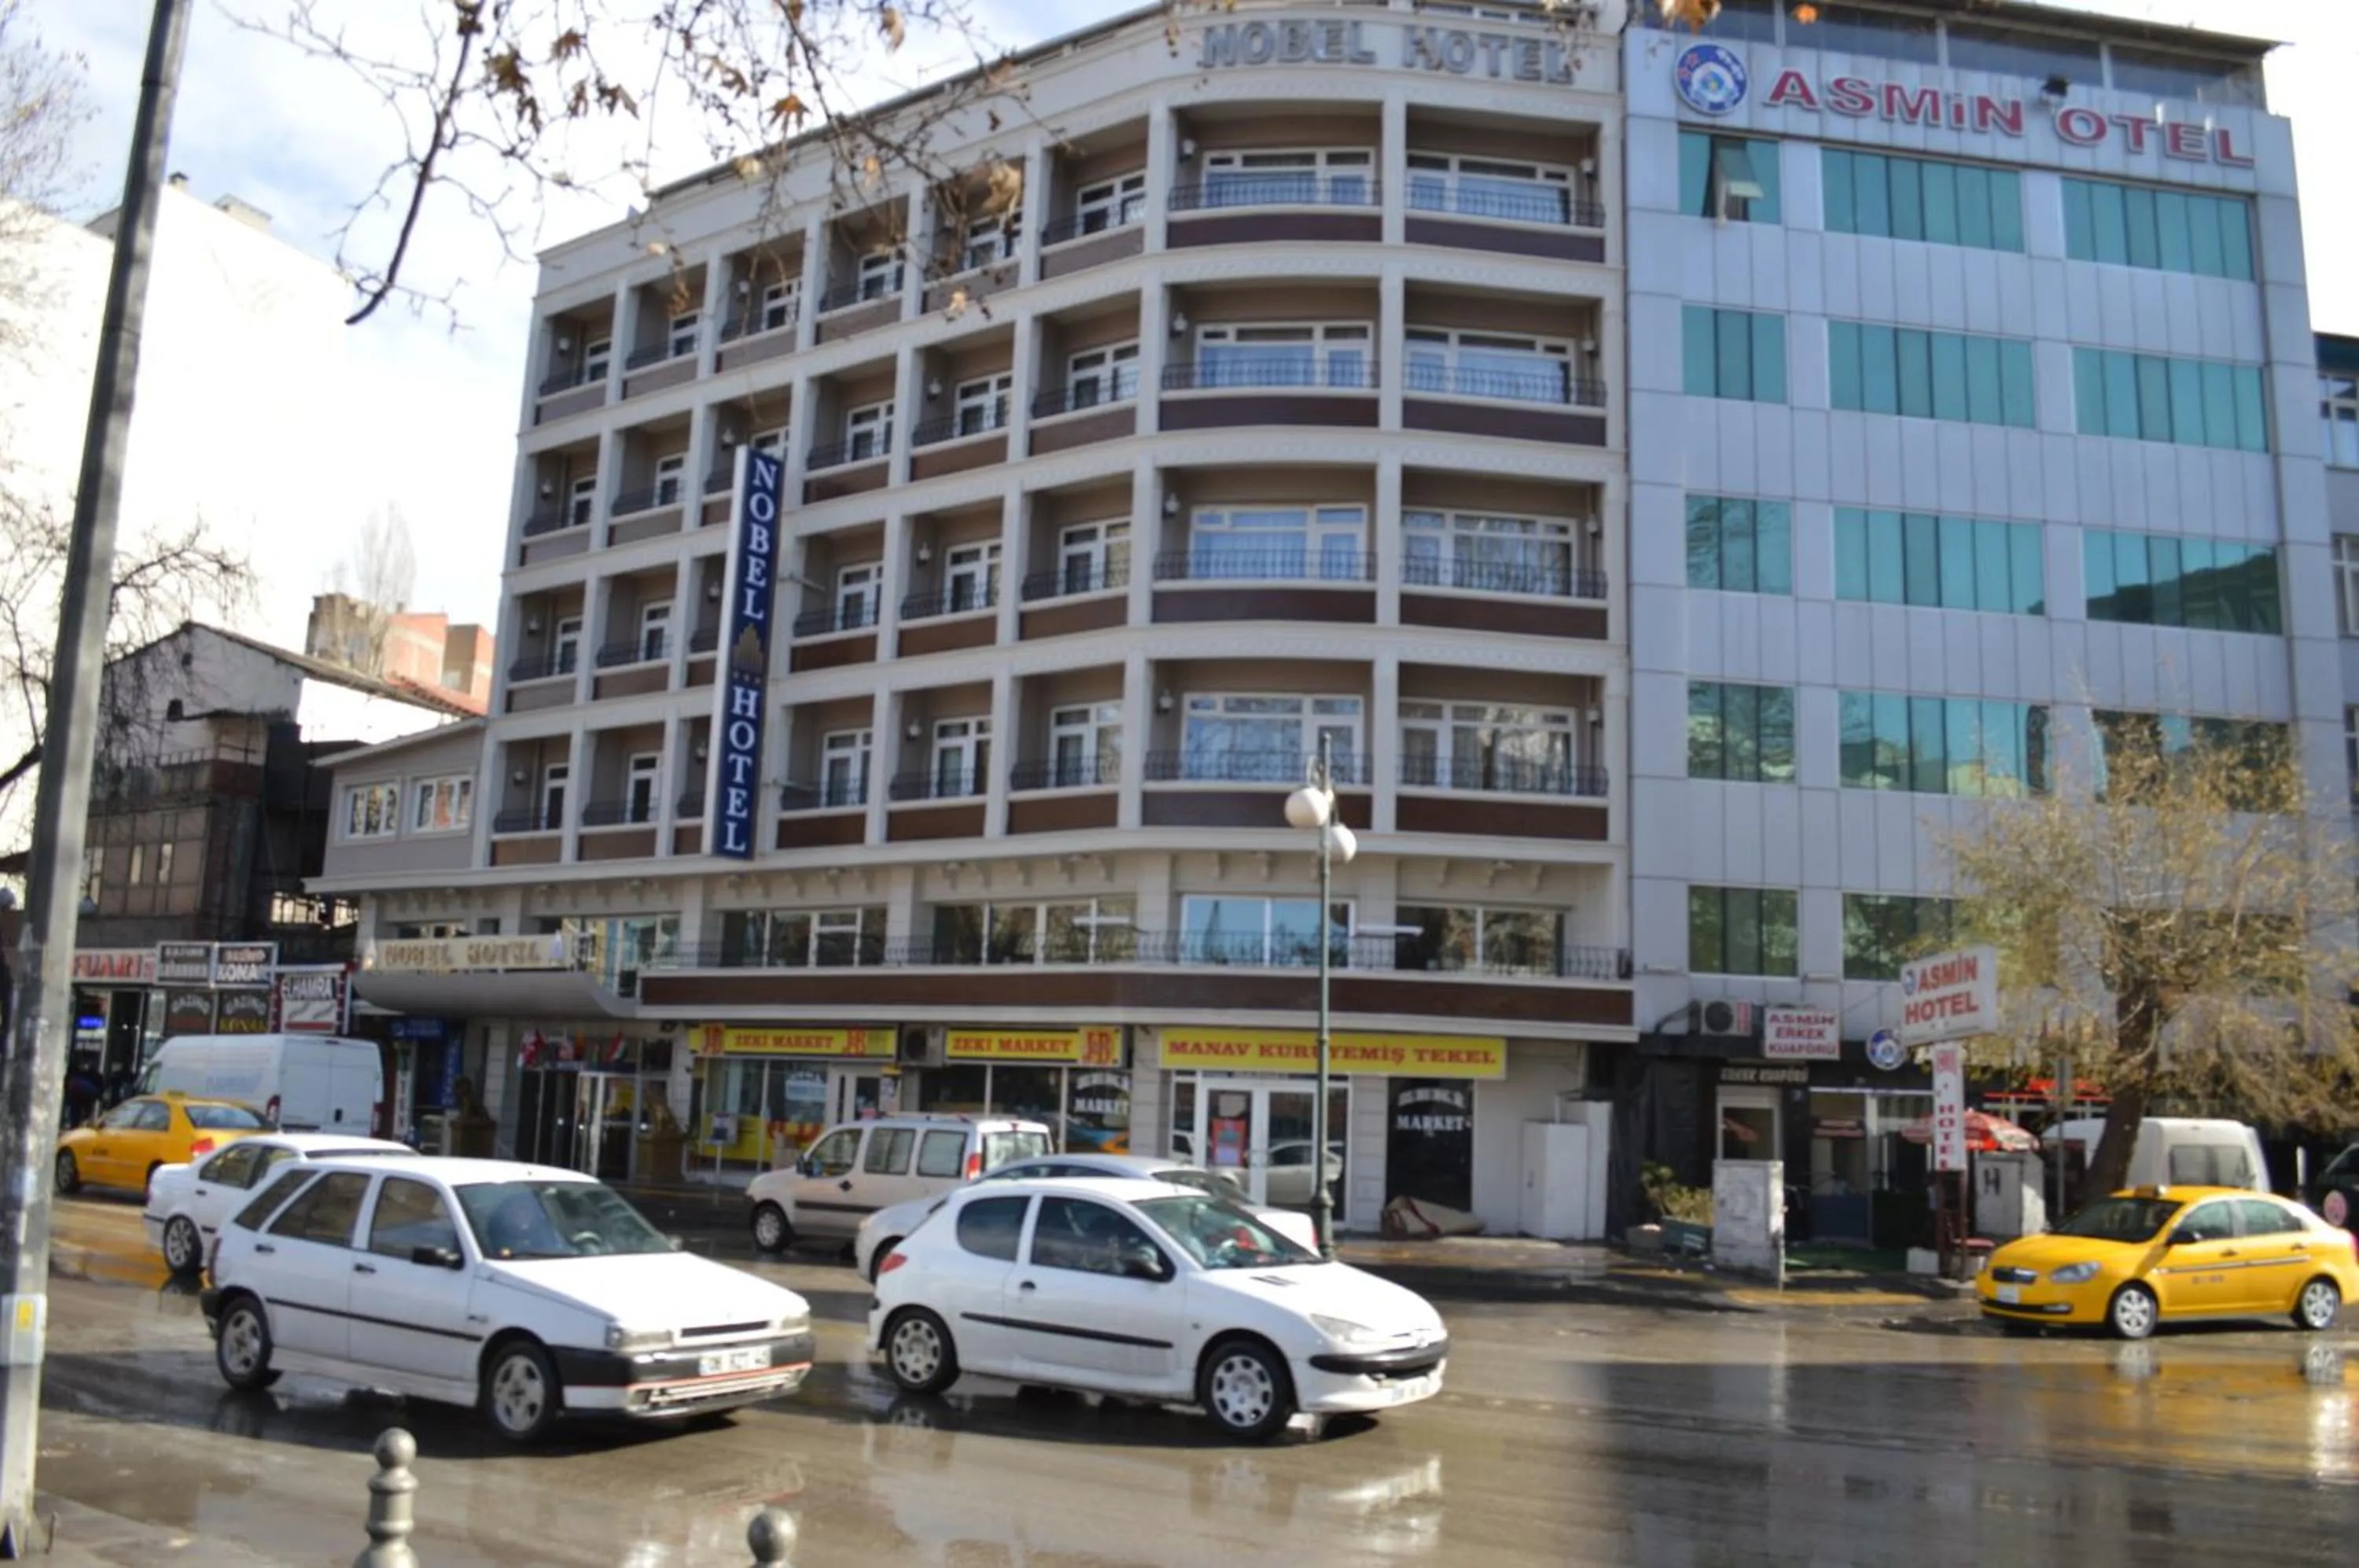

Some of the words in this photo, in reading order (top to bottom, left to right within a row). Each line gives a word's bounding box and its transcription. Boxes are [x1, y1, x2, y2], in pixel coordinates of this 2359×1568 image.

[1202, 19, 1376, 68] NOBEL
[1401, 24, 1573, 85] HOTEL
[2054, 106, 2255, 167] OTEL
[743, 458, 778, 620] NOBEL
[724, 686, 759, 852] HOTEL
[385, 942, 454, 966] NOBEL
[467, 940, 541, 964] HOTEL
[1918, 952, 1978, 994] ASMİN
[1904, 991, 1979, 1025] HOTEL
[774, 1035, 835, 1049] MARKET
[1776, 1027, 1825, 1038] ERKEK
[998, 1038, 1073, 1054] MARKET
[1168, 1040, 1251, 1057] MANAV
[1415, 1048, 1497, 1065] TEKEL
[1074, 1096, 1130, 1113] MARKET
[1397, 1115, 1464, 1131] MARKET
